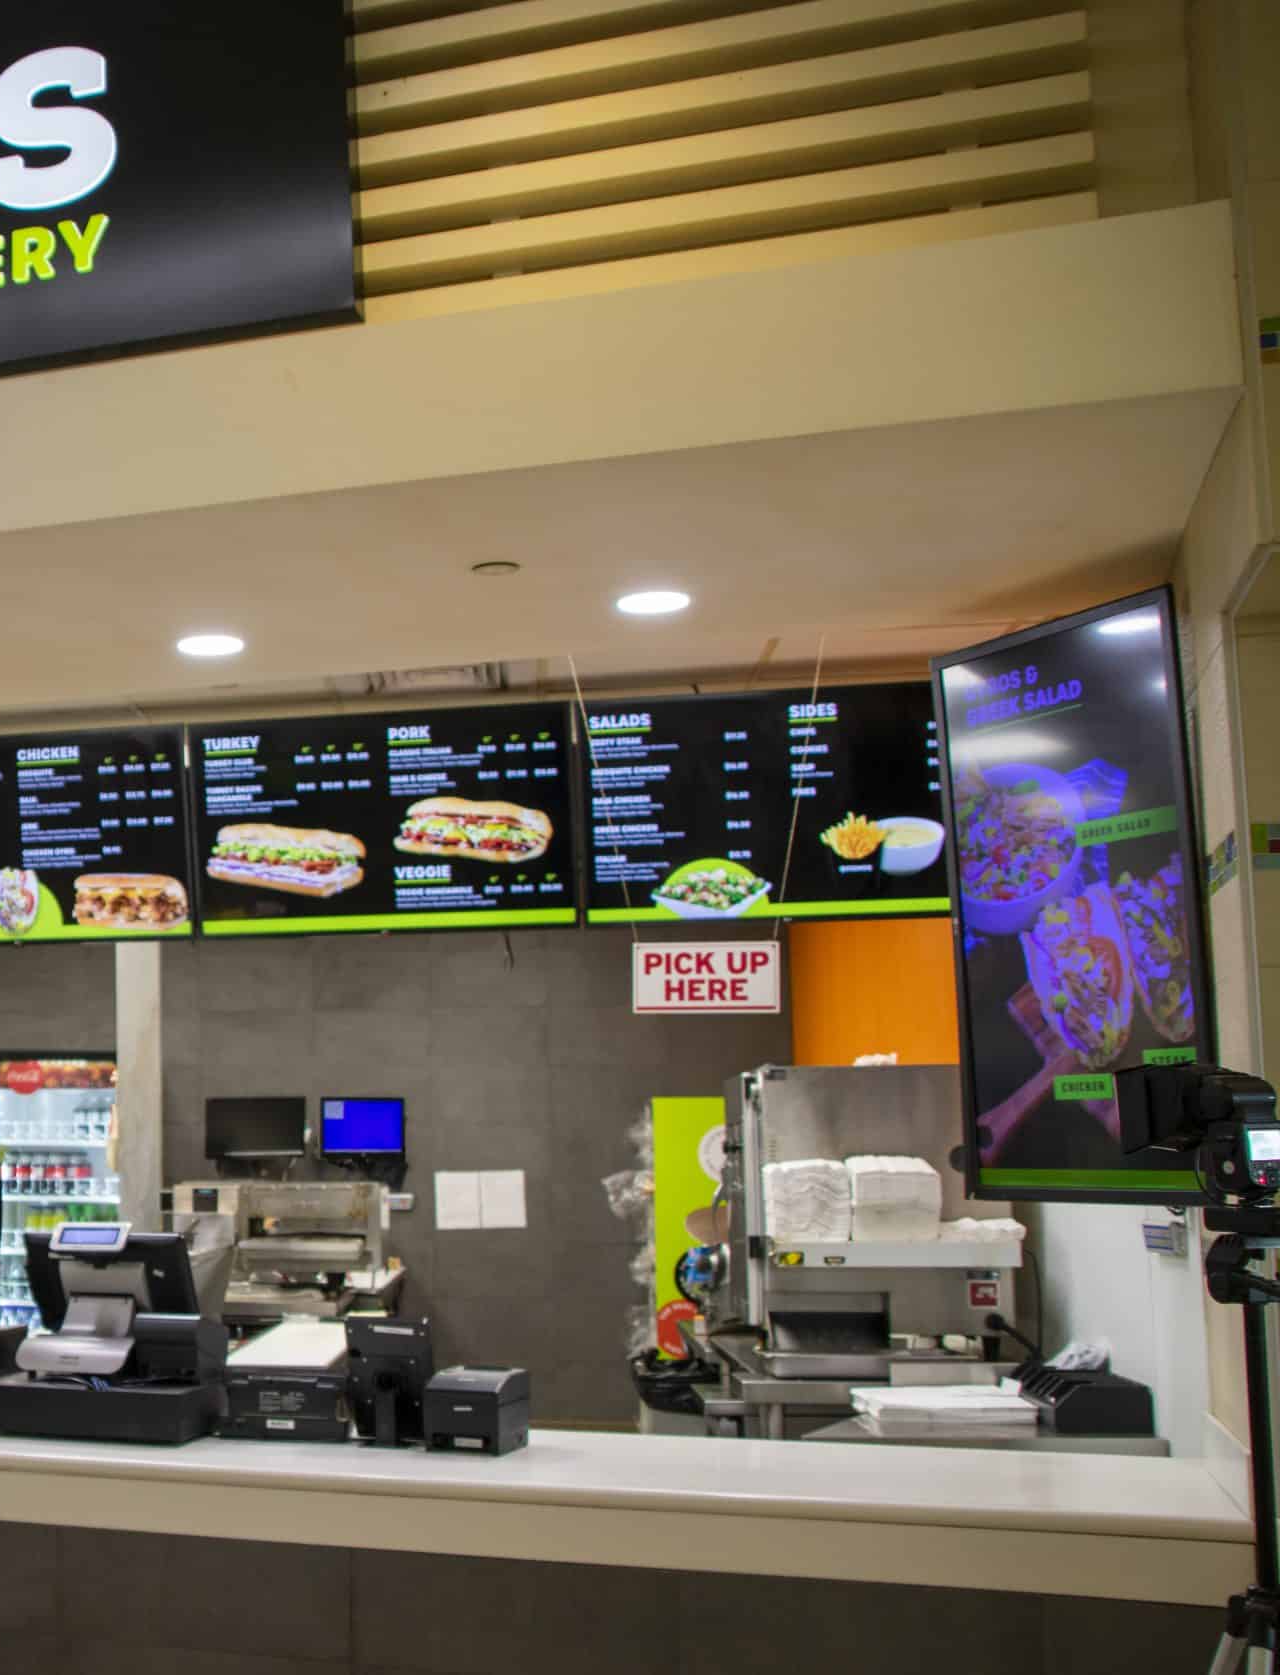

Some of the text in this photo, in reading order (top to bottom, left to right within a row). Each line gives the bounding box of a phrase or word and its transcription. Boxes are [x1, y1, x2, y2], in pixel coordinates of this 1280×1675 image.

[1023, 679, 1083, 711] SALAD
[789, 703, 838, 717] SIDES
[589, 713, 651, 728] SALADS
[387, 726, 430, 739] PORK
[203, 736, 260, 750] TURKEY
[17, 746, 80, 760] CHICKEN
[394, 865, 451, 879] VEGGIE
[644, 951, 769, 975] PICK UP
[664, 978, 749, 1001] HERE
